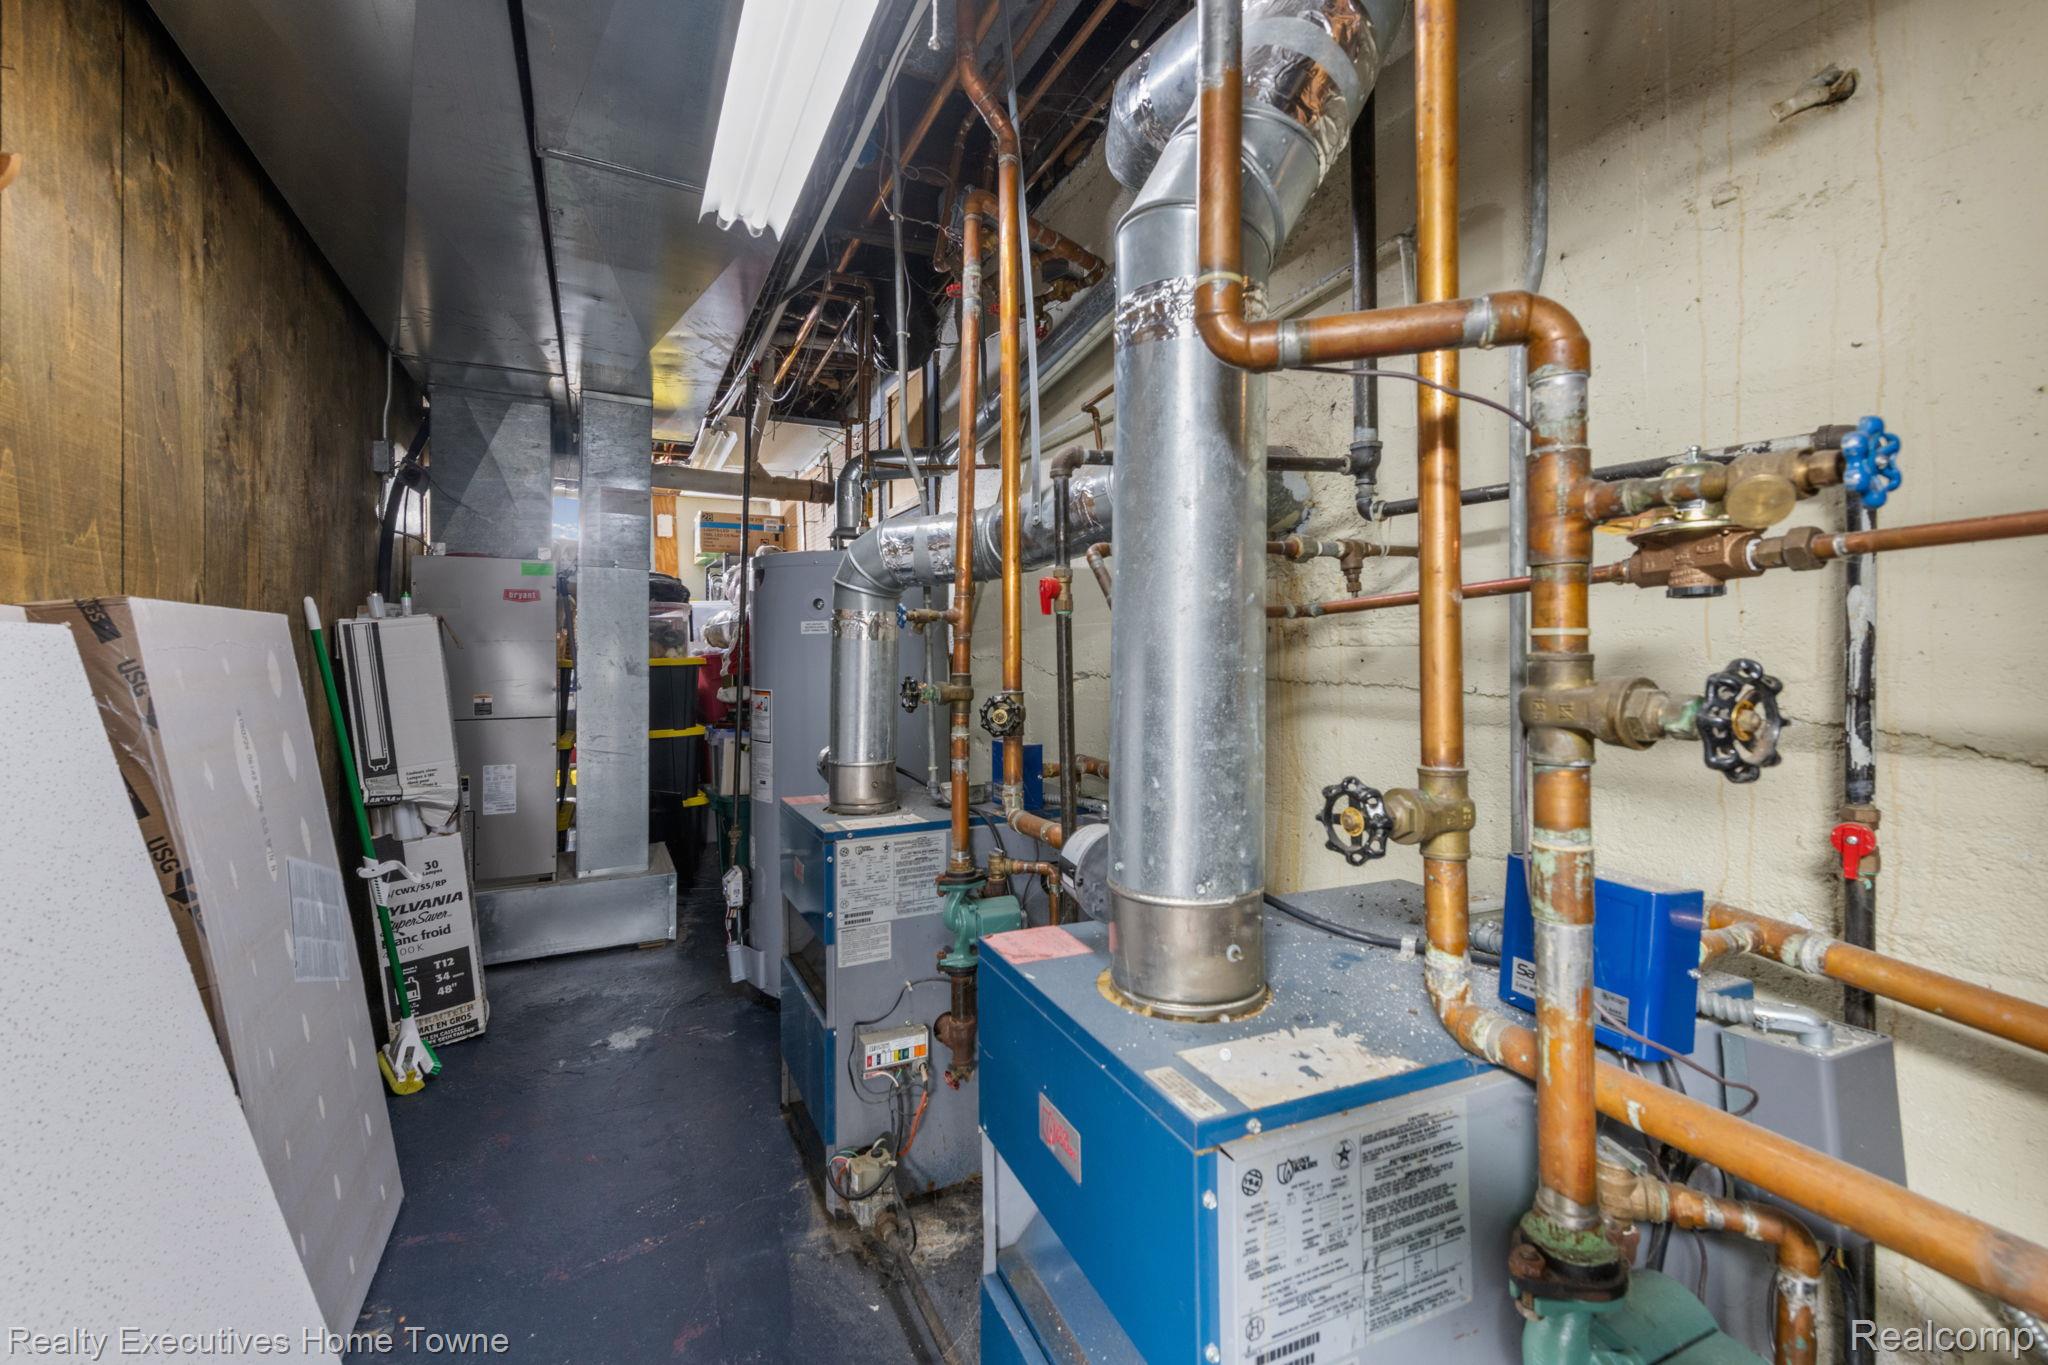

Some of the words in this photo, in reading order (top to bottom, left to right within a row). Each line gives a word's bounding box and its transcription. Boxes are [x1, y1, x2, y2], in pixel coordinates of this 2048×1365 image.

[508, 591, 537, 600] bryant
[117, 658, 147, 697] USG
[146, 835, 181, 875] USG
[424, 860, 439, 871] 30
[378, 891, 464, 919] YLVANIA
[421, 923, 452, 941] froid
[433, 957, 456, 970] T12
[1516, 962, 1537, 980] Sa
[434, 971, 451, 984] 34
[436, 1018, 451, 1029] EN
[450, 1012, 473, 1025] GROS
